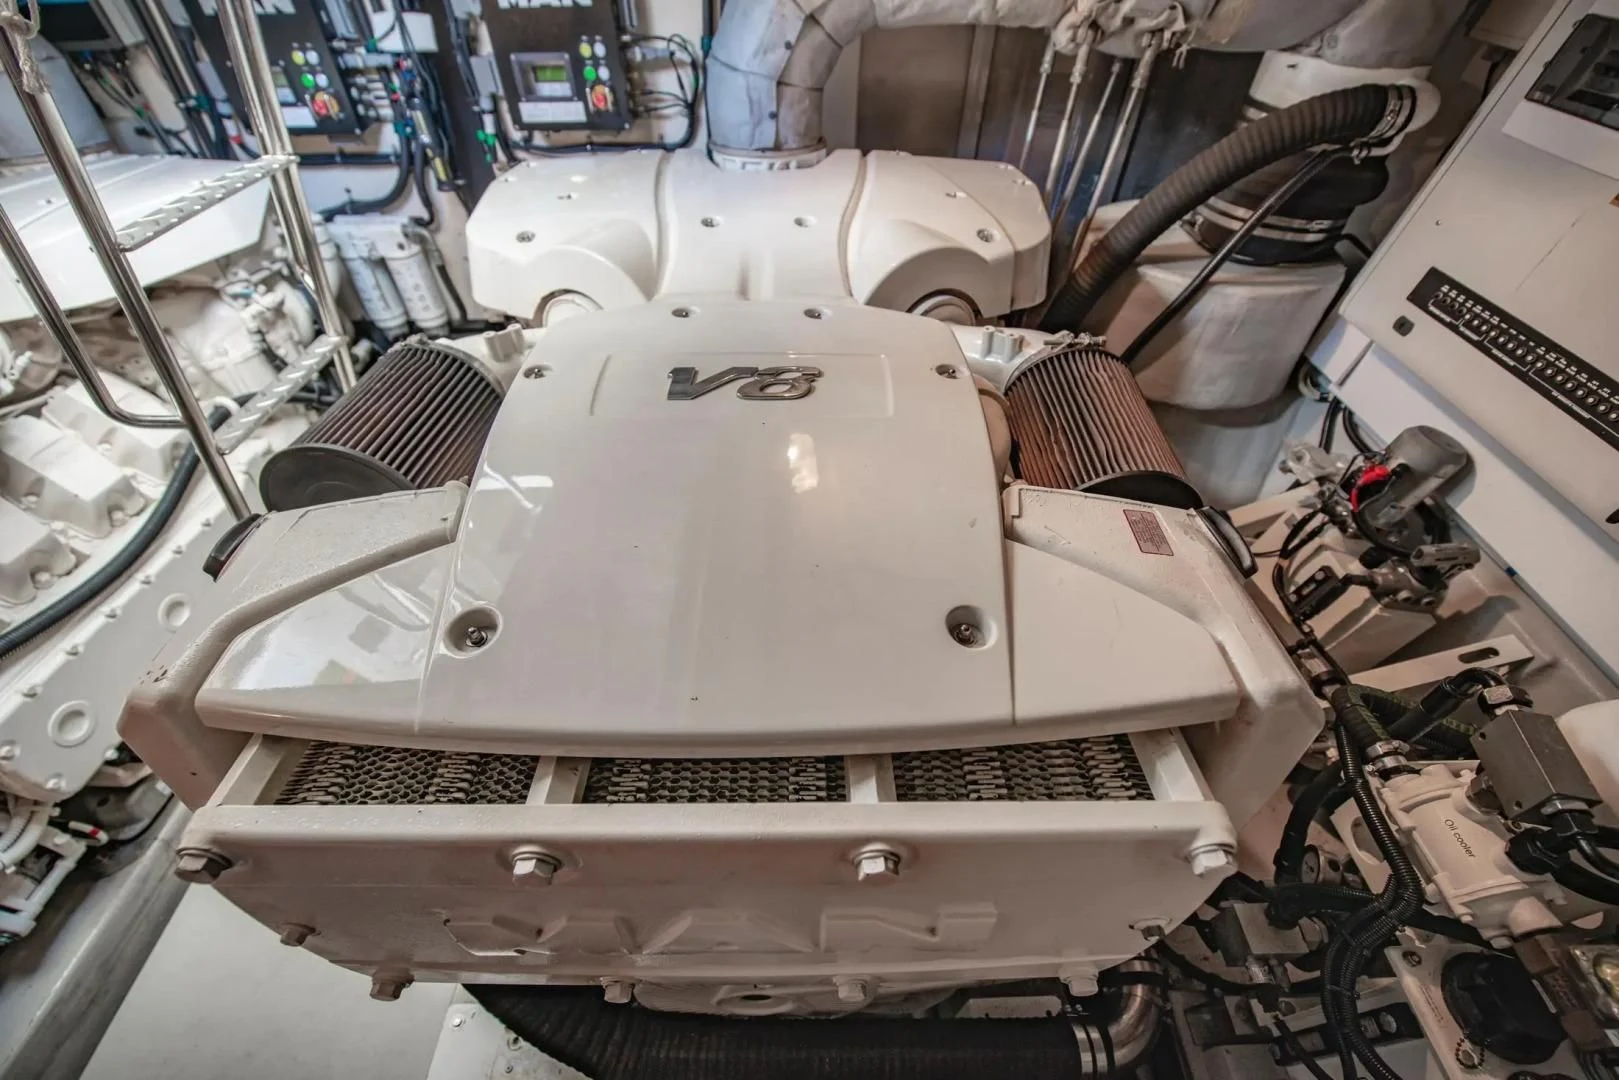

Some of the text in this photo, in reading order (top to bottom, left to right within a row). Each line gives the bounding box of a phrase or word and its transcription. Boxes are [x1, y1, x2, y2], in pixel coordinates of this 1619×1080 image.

[667, 366, 824, 400] V8
[1444, 819, 1475, 857] Oil cooler
